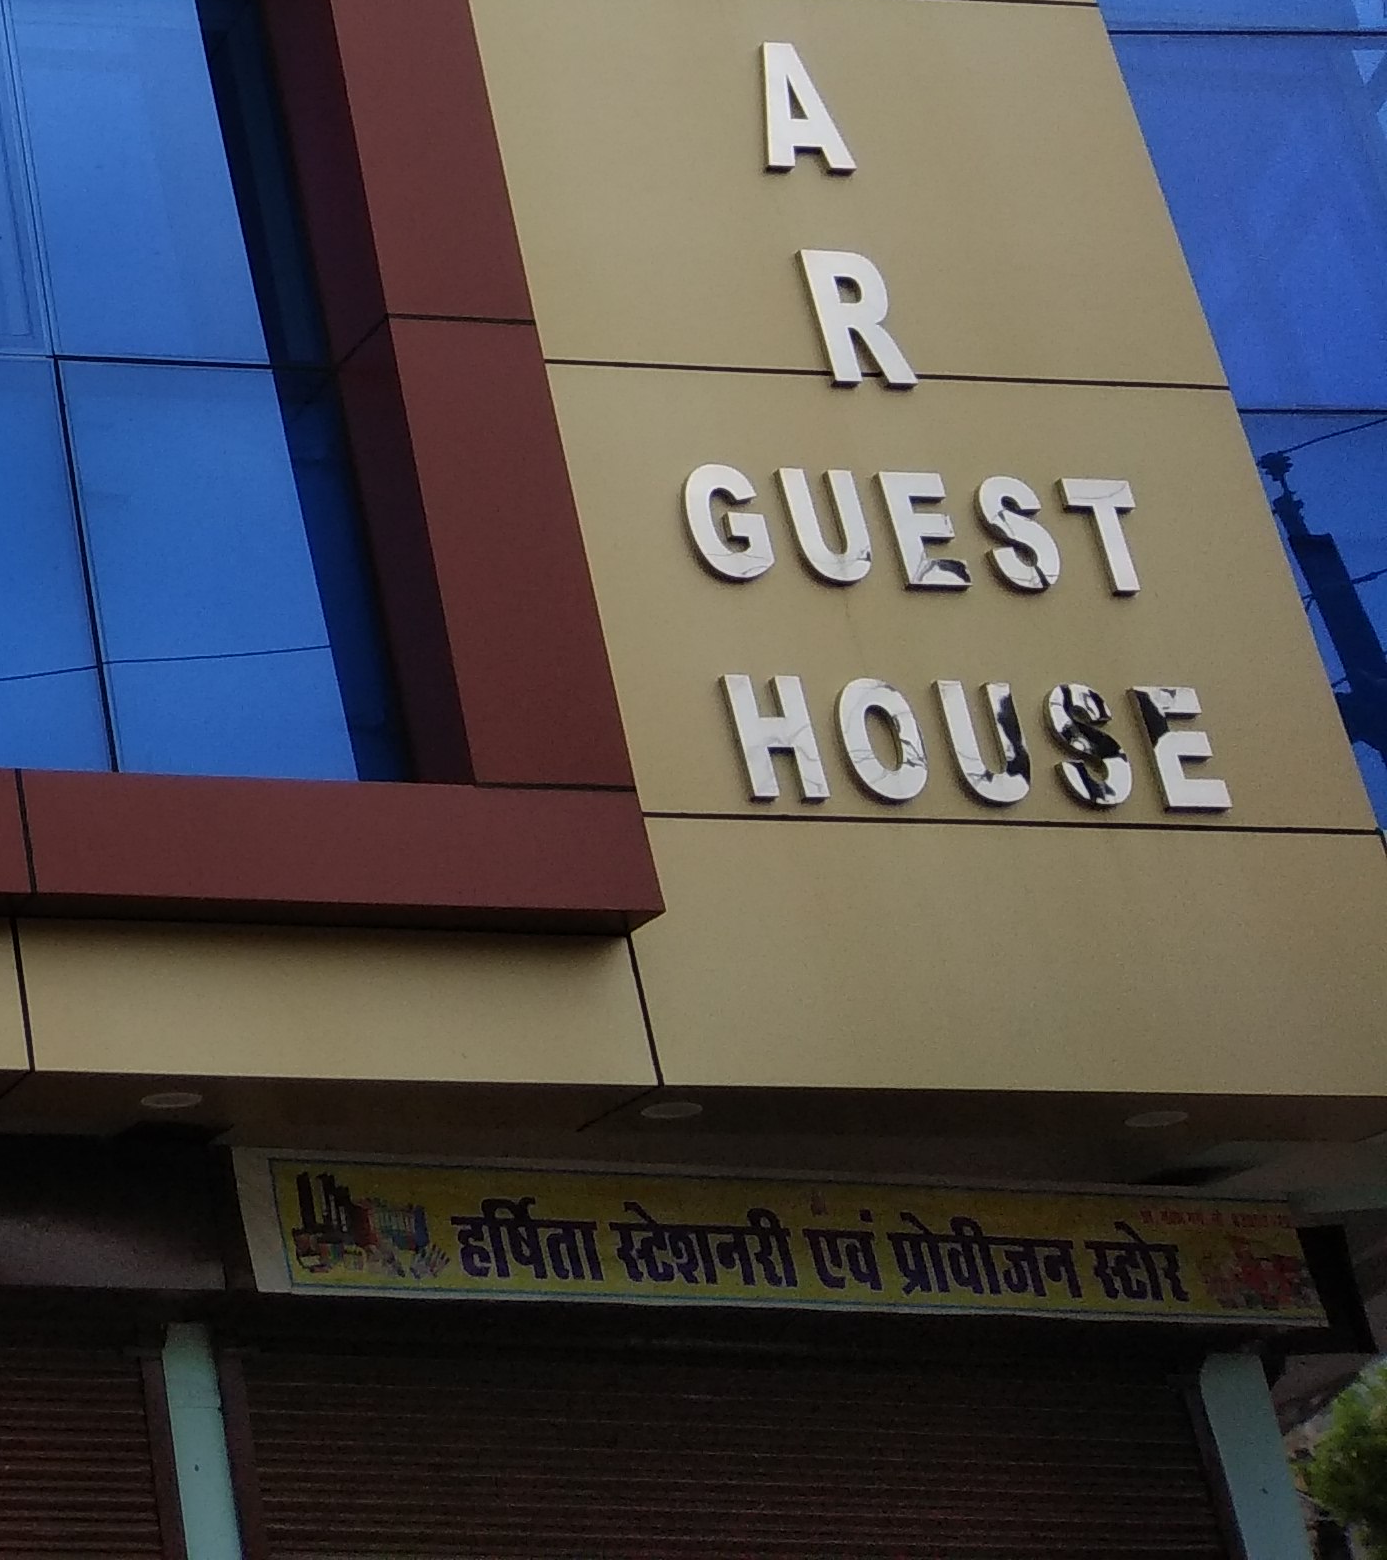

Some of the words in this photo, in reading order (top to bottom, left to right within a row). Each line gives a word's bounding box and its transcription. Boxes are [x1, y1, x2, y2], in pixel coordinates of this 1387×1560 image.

[681, 462, 1141, 596] GUEST
[718, 673, 1233, 811] HOUSE
[451, 1196, 604, 1282] हर्षिता
[609, 1201, 799, 1288] स्टेशनरी
[803, 1209, 884, 1292] एवं
[886, 1212, 1084, 1299] प्रोवीजन
[1085, 1221, 1190, 1302] स्टोर
